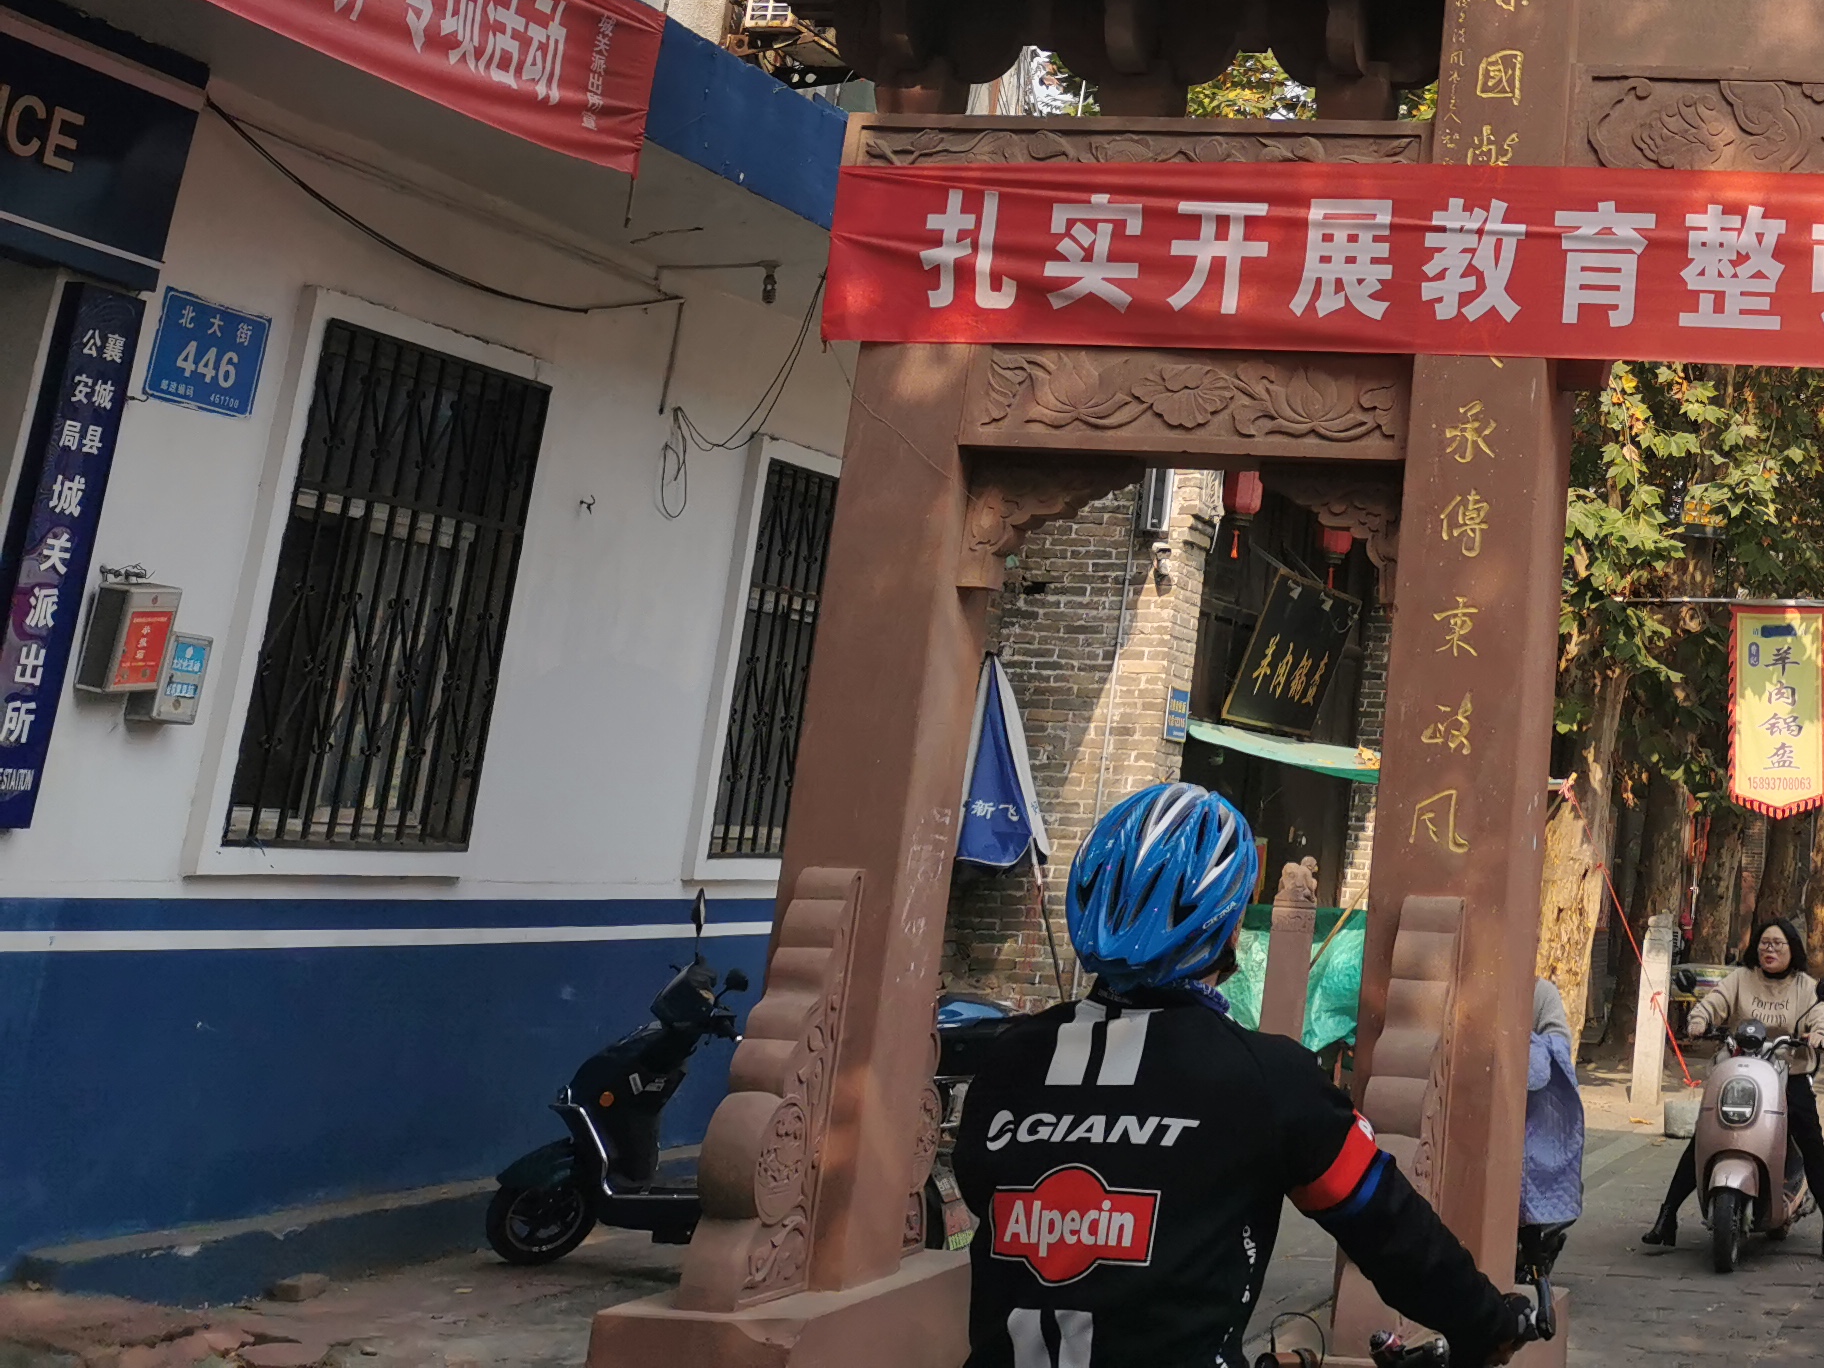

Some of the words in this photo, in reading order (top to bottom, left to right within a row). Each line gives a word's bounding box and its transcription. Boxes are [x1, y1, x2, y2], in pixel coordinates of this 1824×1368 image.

[178, 305, 253, 347] 北大街
[58, 328, 103, 452] 公安局
[160, 378, 195, 398] 邮政编码
[176, 340, 239, 389] 446
[81, 331, 127, 456] 襄城县
[0, 473, 87, 745] 城关派出所
[1758, 645, 1804, 770] 羊肉锅盔
[1751, 996, 1790, 1011] Forrest
[1016, 1113, 1201, 1147] GIANT
[1003, 1199, 1135, 1258] Alpecin
